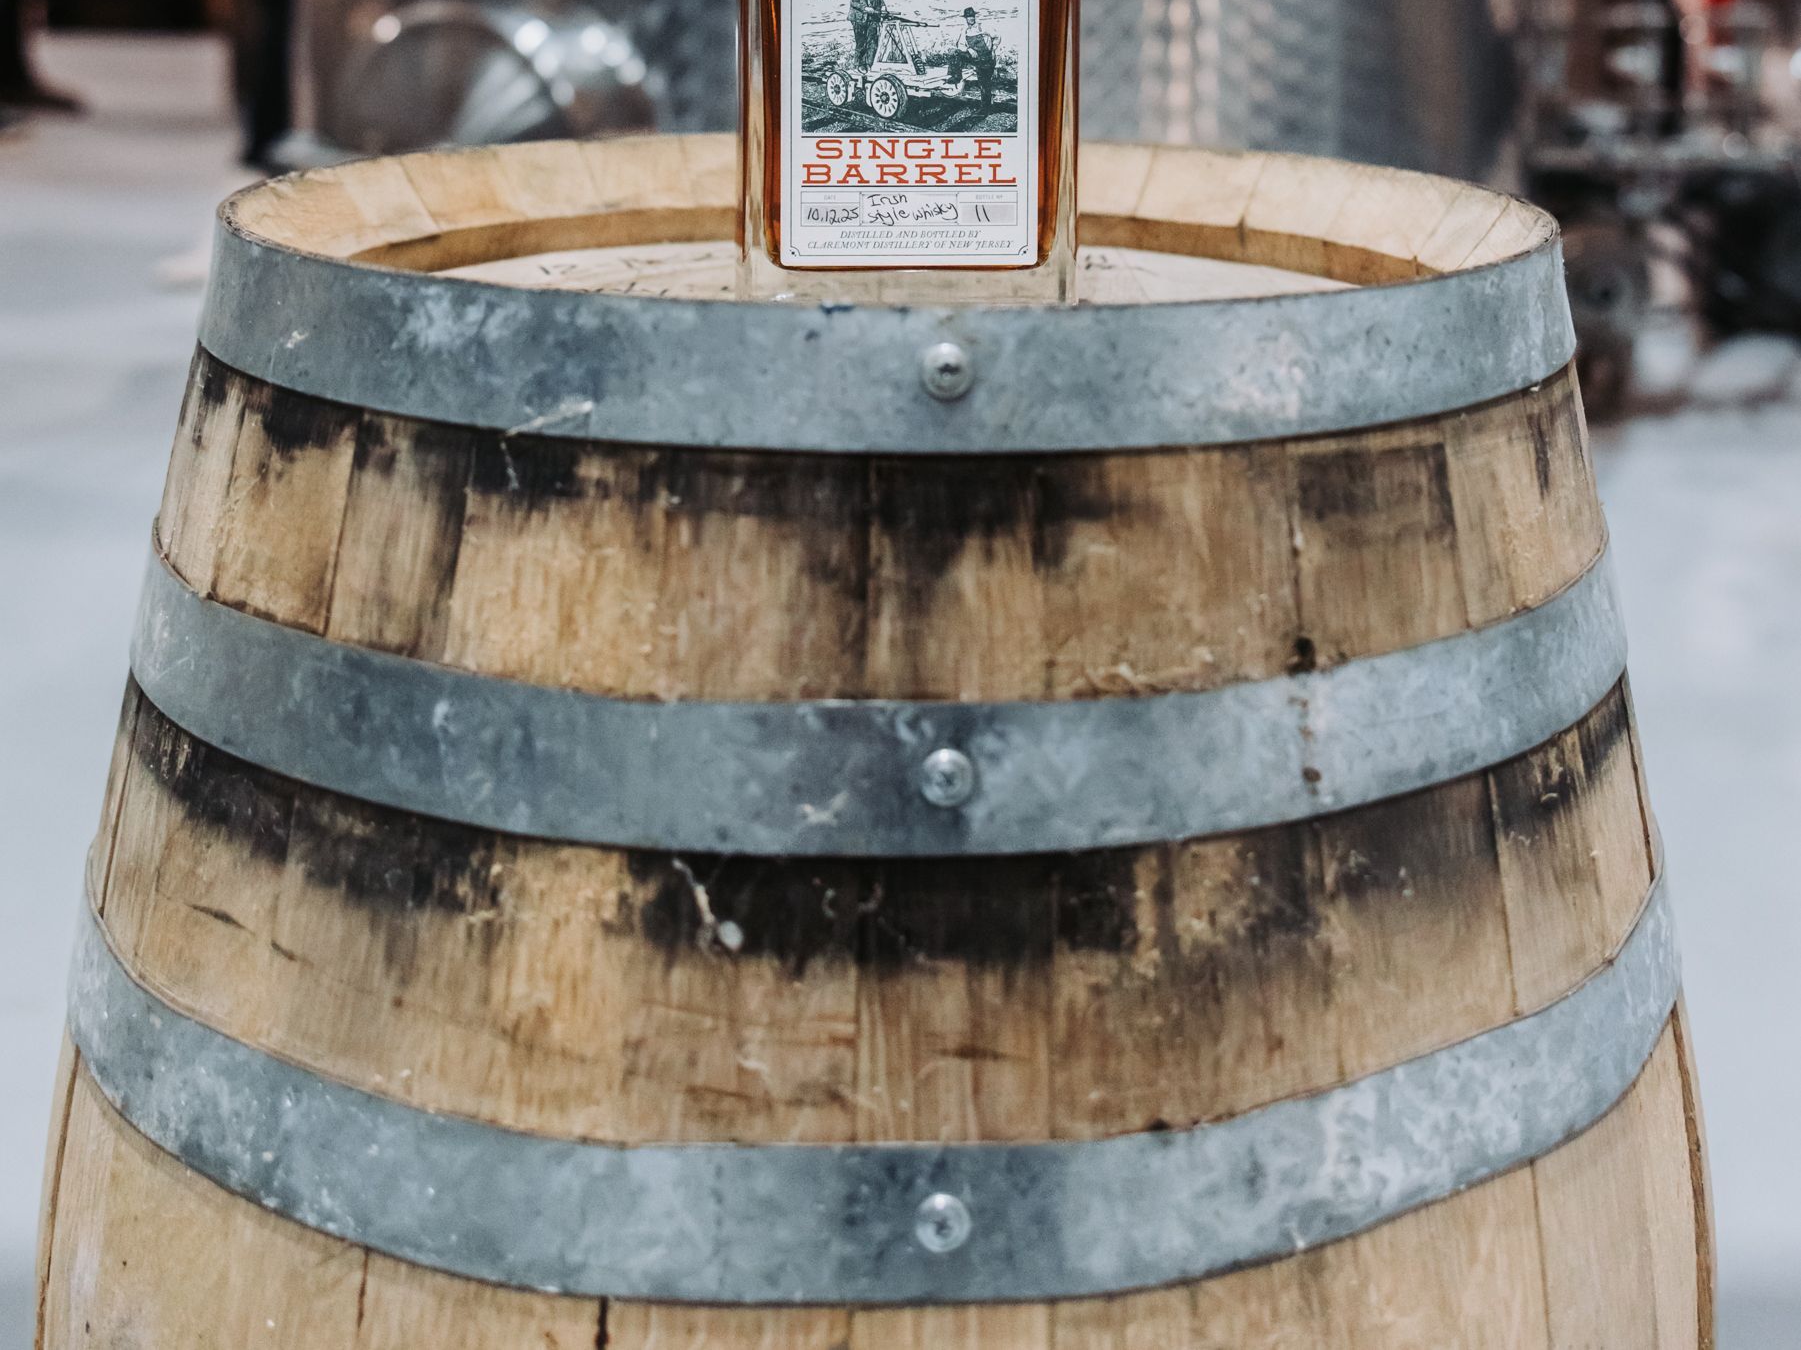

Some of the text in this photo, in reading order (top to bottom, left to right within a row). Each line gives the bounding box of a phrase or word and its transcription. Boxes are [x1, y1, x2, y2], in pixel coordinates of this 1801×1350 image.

[815, 139, 1002, 159] SINGLE
[802, 163, 1017, 184] BARREL
[912, 202, 959, 221] whisky
[839, 230, 981, 239] DISTILLED AND BOTTLED BY
[807, 240, 1014, 250] CLAREMONT DISTILLERY OF NEW JERSEY
